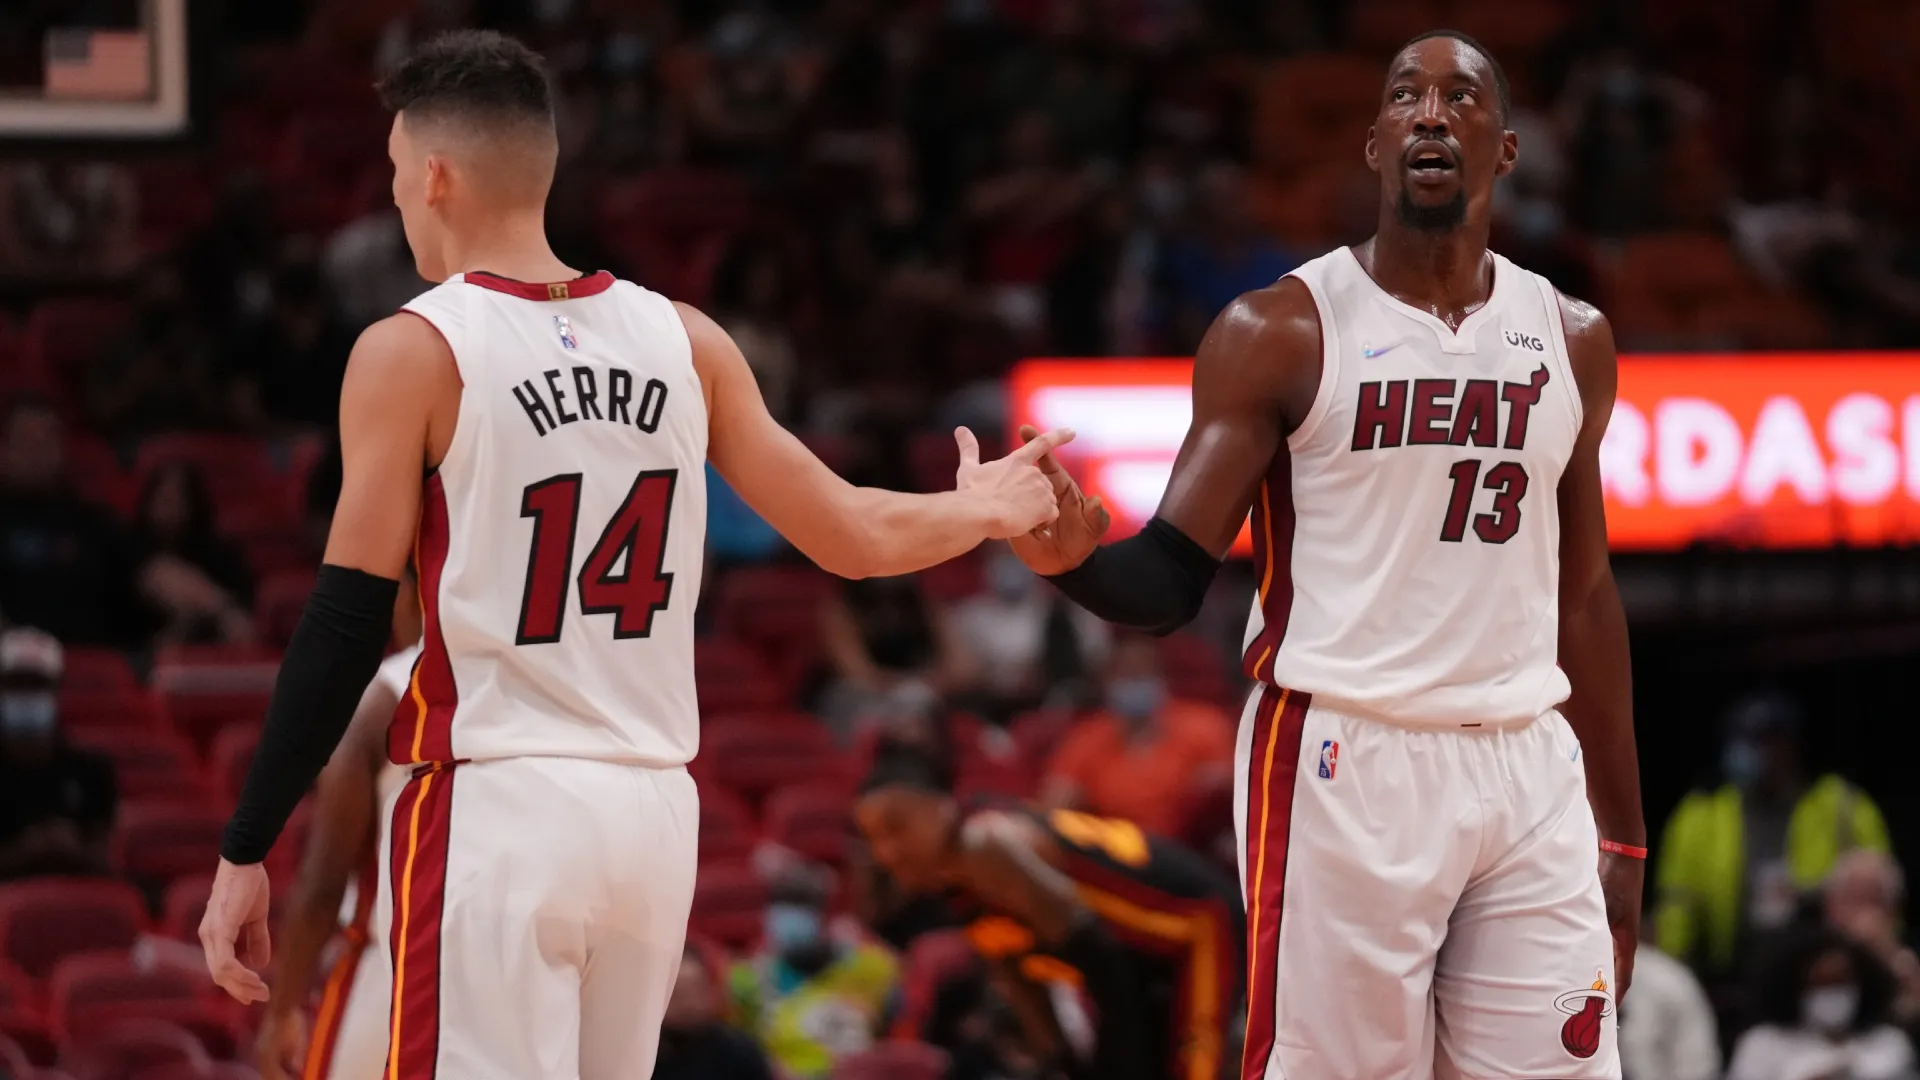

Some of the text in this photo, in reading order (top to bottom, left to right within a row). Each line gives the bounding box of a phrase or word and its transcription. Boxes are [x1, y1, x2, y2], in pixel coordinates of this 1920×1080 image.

[512, 366, 669, 437] HERRO
[1351, 362, 1550, 451] HEAT
[1598, 392, 1920, 508] RDAS
[1440, 459, 1529, 544] 13
[515, 468, 679, 646] 14
